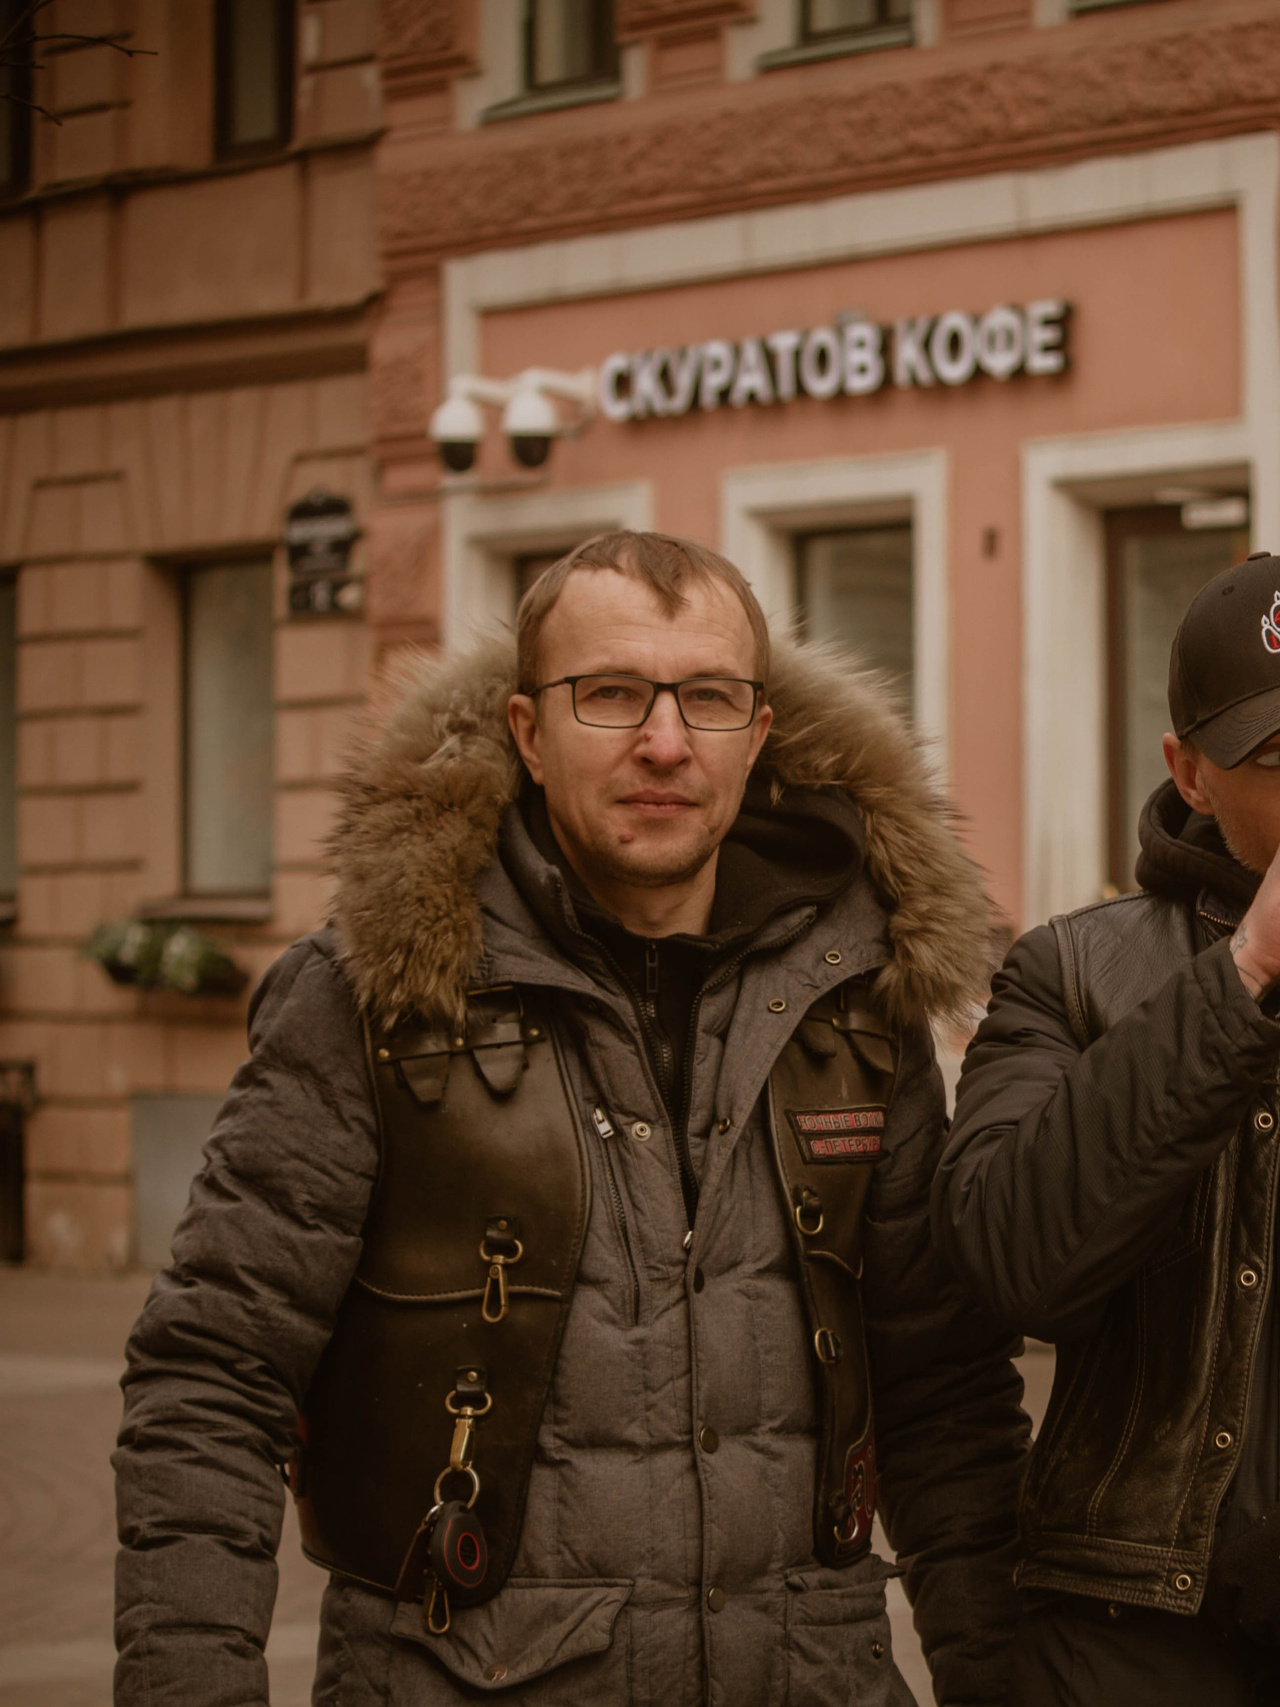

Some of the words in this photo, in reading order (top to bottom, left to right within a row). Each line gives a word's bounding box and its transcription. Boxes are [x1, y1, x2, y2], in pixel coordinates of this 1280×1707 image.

[600, 320, 886, 421] СКУРАТОВ
[894, 300, 1070, 387] КОФЕ
[797, 1112, 852, 1131] НОЧНЫЕ
